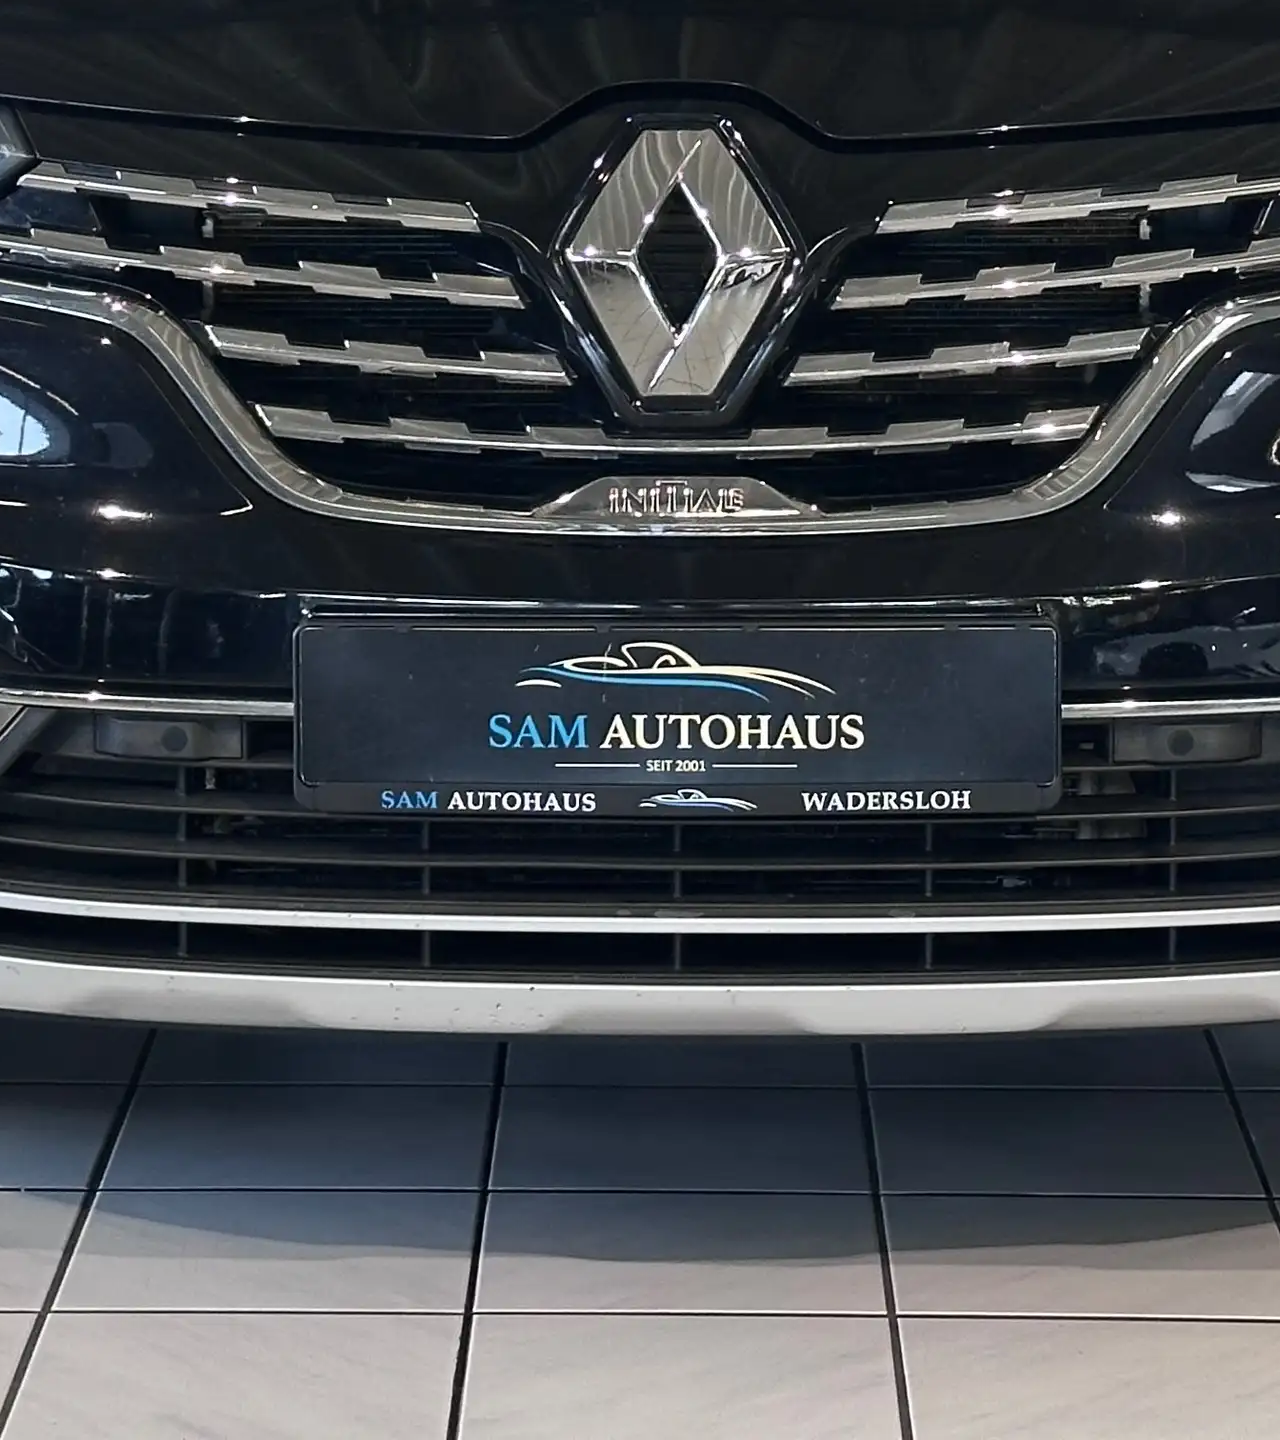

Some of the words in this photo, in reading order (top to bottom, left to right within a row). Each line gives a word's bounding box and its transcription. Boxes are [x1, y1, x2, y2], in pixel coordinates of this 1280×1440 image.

[487, 713, 589, 749] SAM
[599, 712, 866, 750] AUTOHAUS
[645, 759, 674, 773] SEIT
[674, 759, 707, 773] 2001
[380, 790, 439, 810] SAM
[446, 790, 597, 813] AUTOHAUS
[799, 789, 972, 812] WADERSLOH
